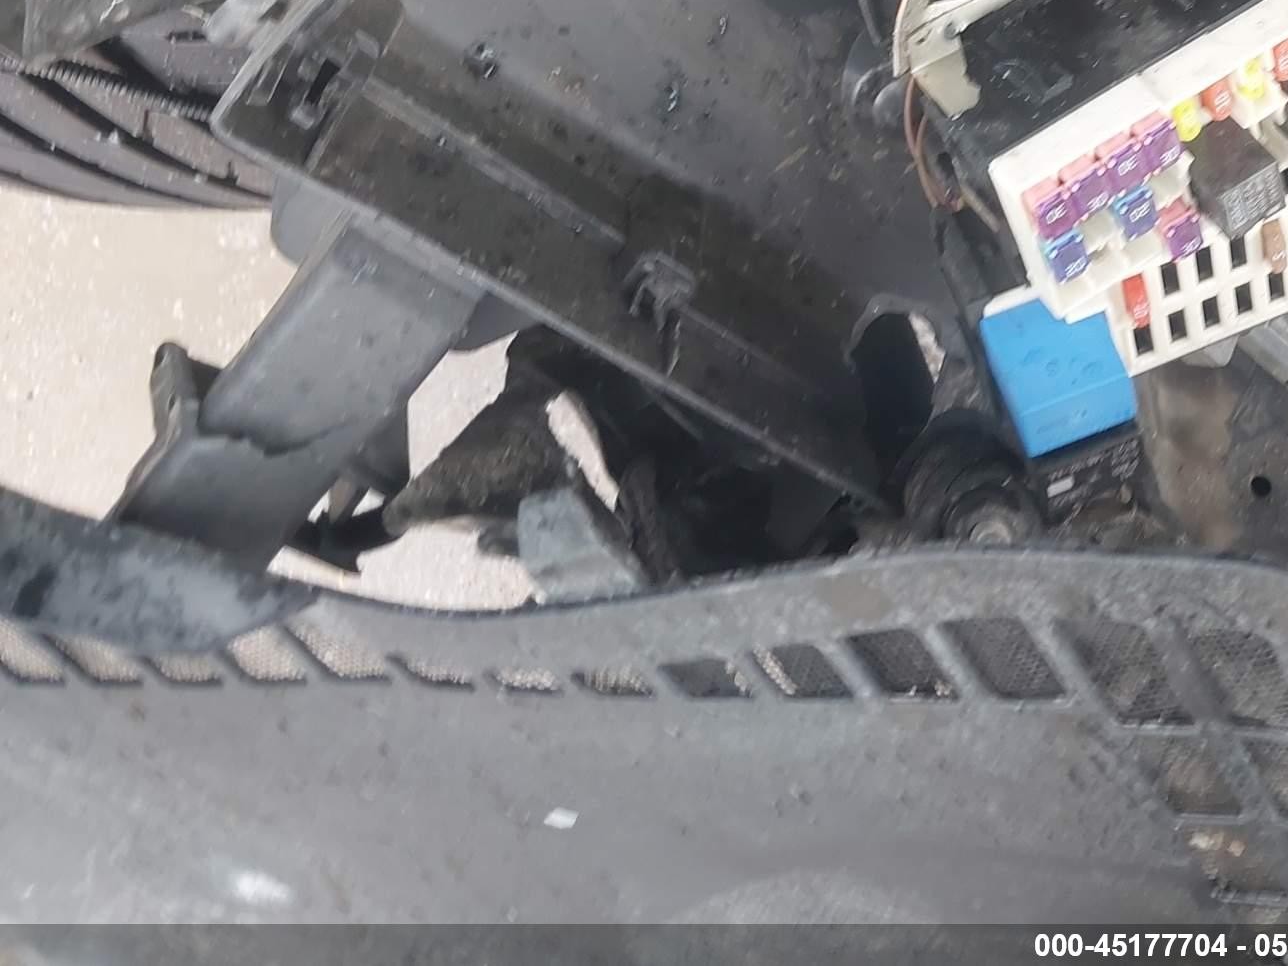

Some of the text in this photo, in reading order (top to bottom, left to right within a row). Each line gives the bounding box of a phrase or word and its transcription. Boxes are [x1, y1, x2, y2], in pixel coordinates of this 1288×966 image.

[1117, 154, 1138, 176] 30
[1160, 145, 1181, 166] 30
[1088, 191, 1109, 213] 30
[1046, 203, 1067, 224] 30
